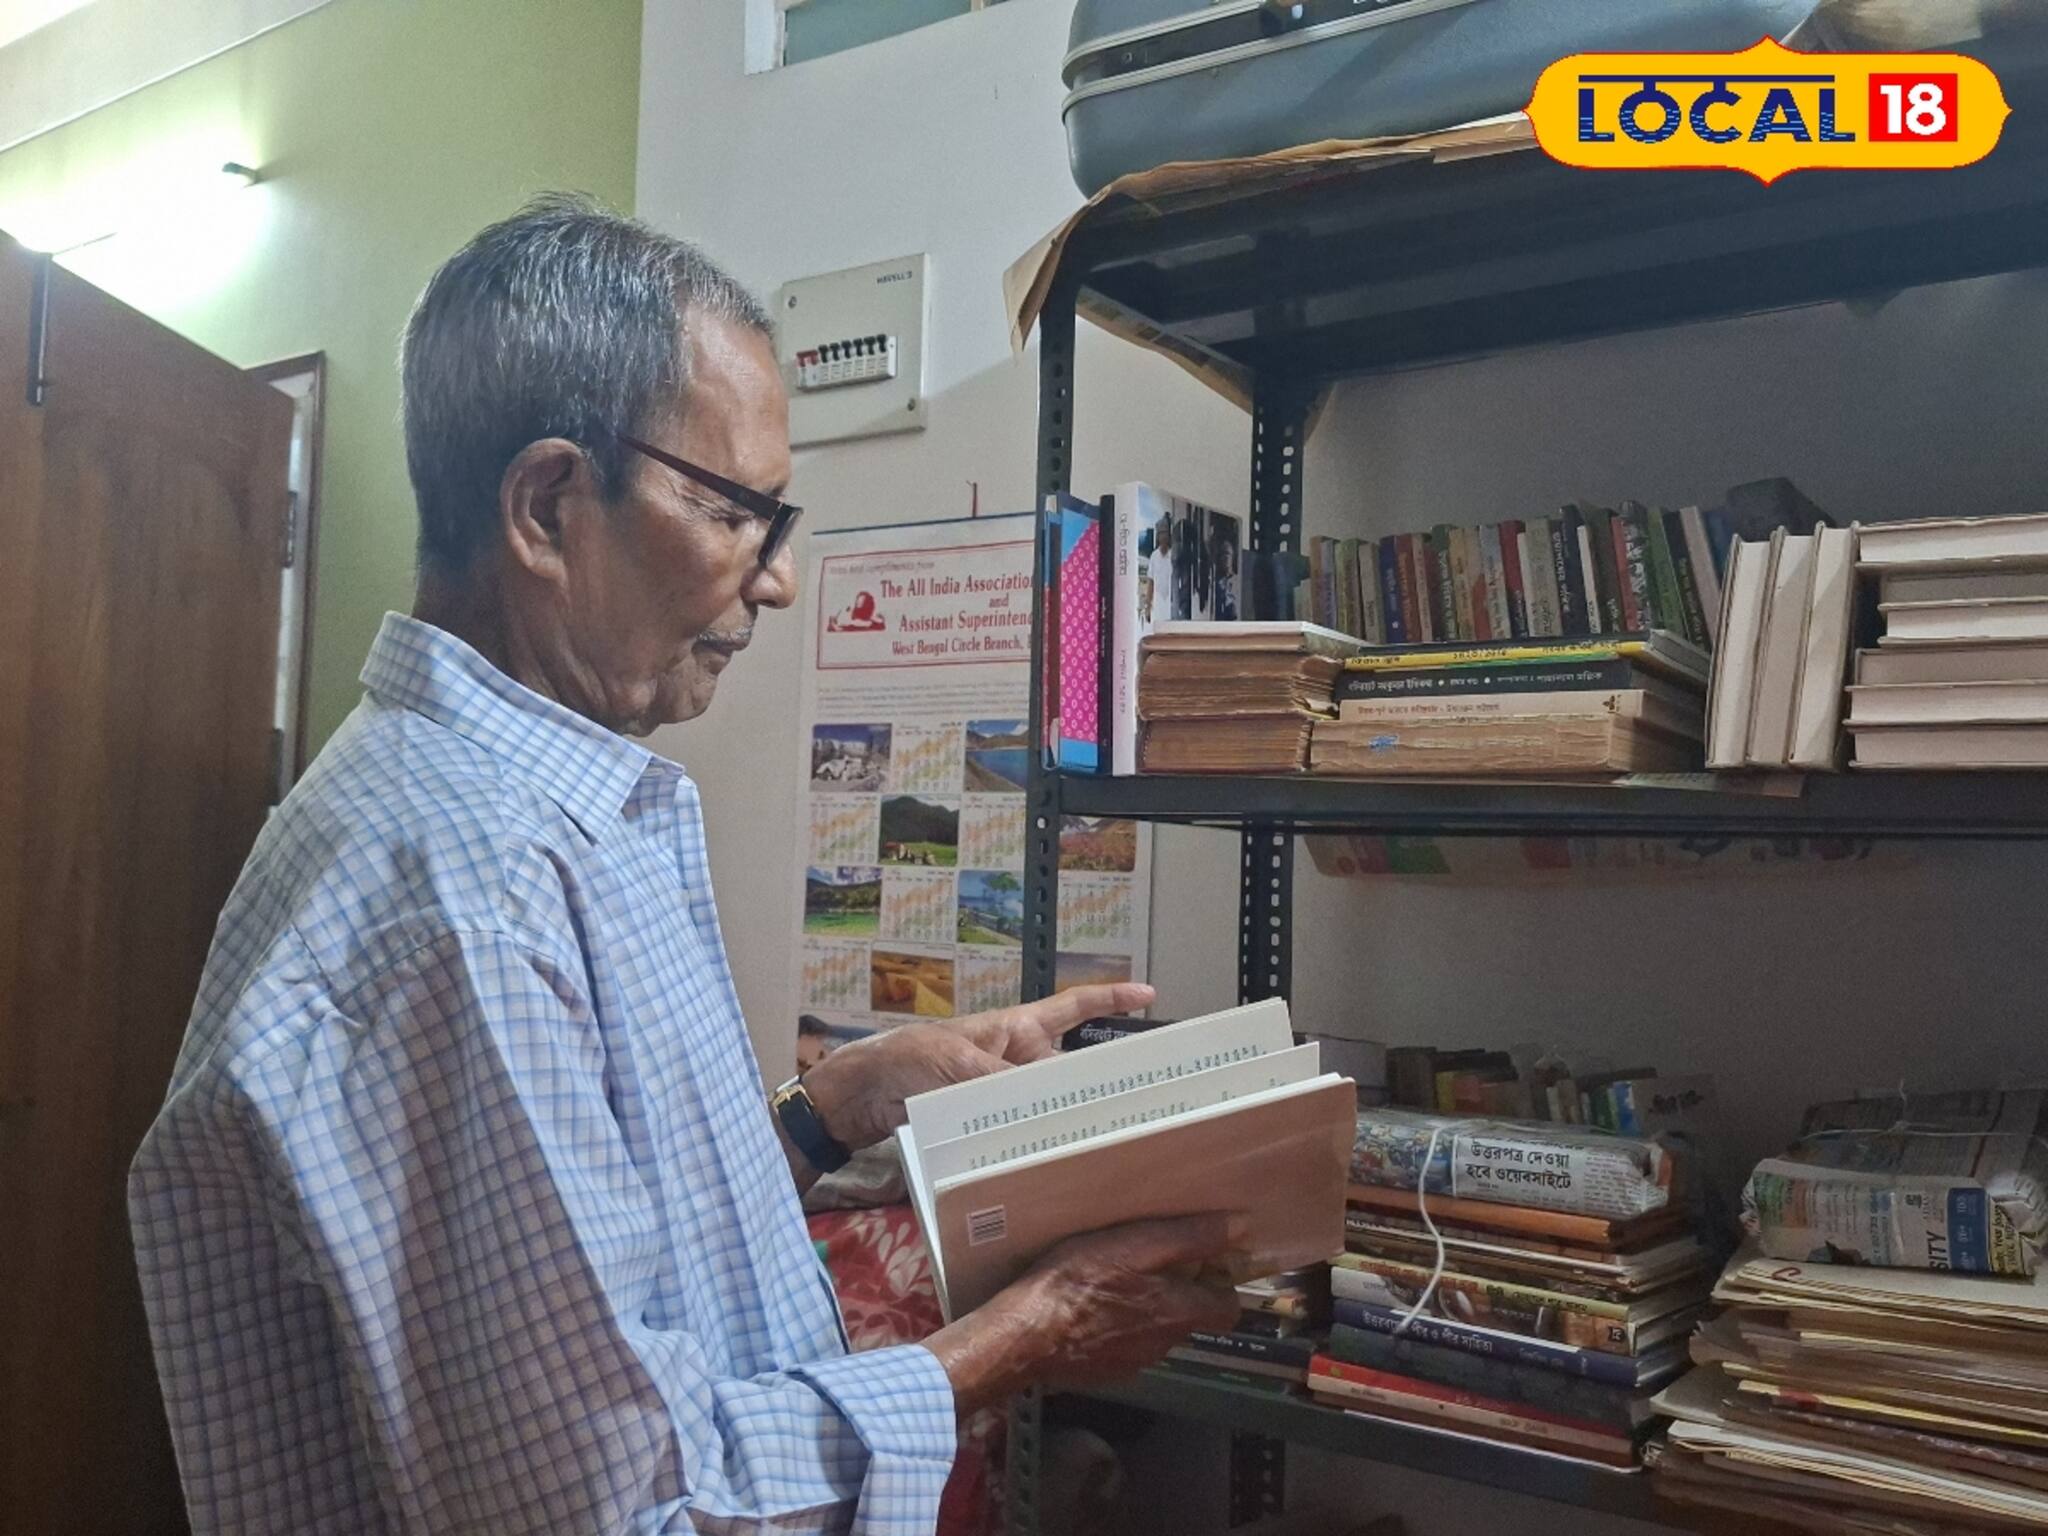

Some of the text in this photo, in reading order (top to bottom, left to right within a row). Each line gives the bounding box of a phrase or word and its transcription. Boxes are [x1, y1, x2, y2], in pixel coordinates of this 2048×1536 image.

[880, 571, 1034, 598] The All India Associatio
[899, 614, 954, 632] Assistant
[892, 640, 914, 655] West
[917, 638, 949, 657] Bengal
[951, 636, 981, 652] Circle
[1471, 1141, 1524, 1163] উত্তরপত্র
[1527, 1150, 1570, 1168] দেওয়া
[1465, 1163, 1492, 1180] হবে
[1496, 1168, 1572, 1190] ওয়েবসাইটে
